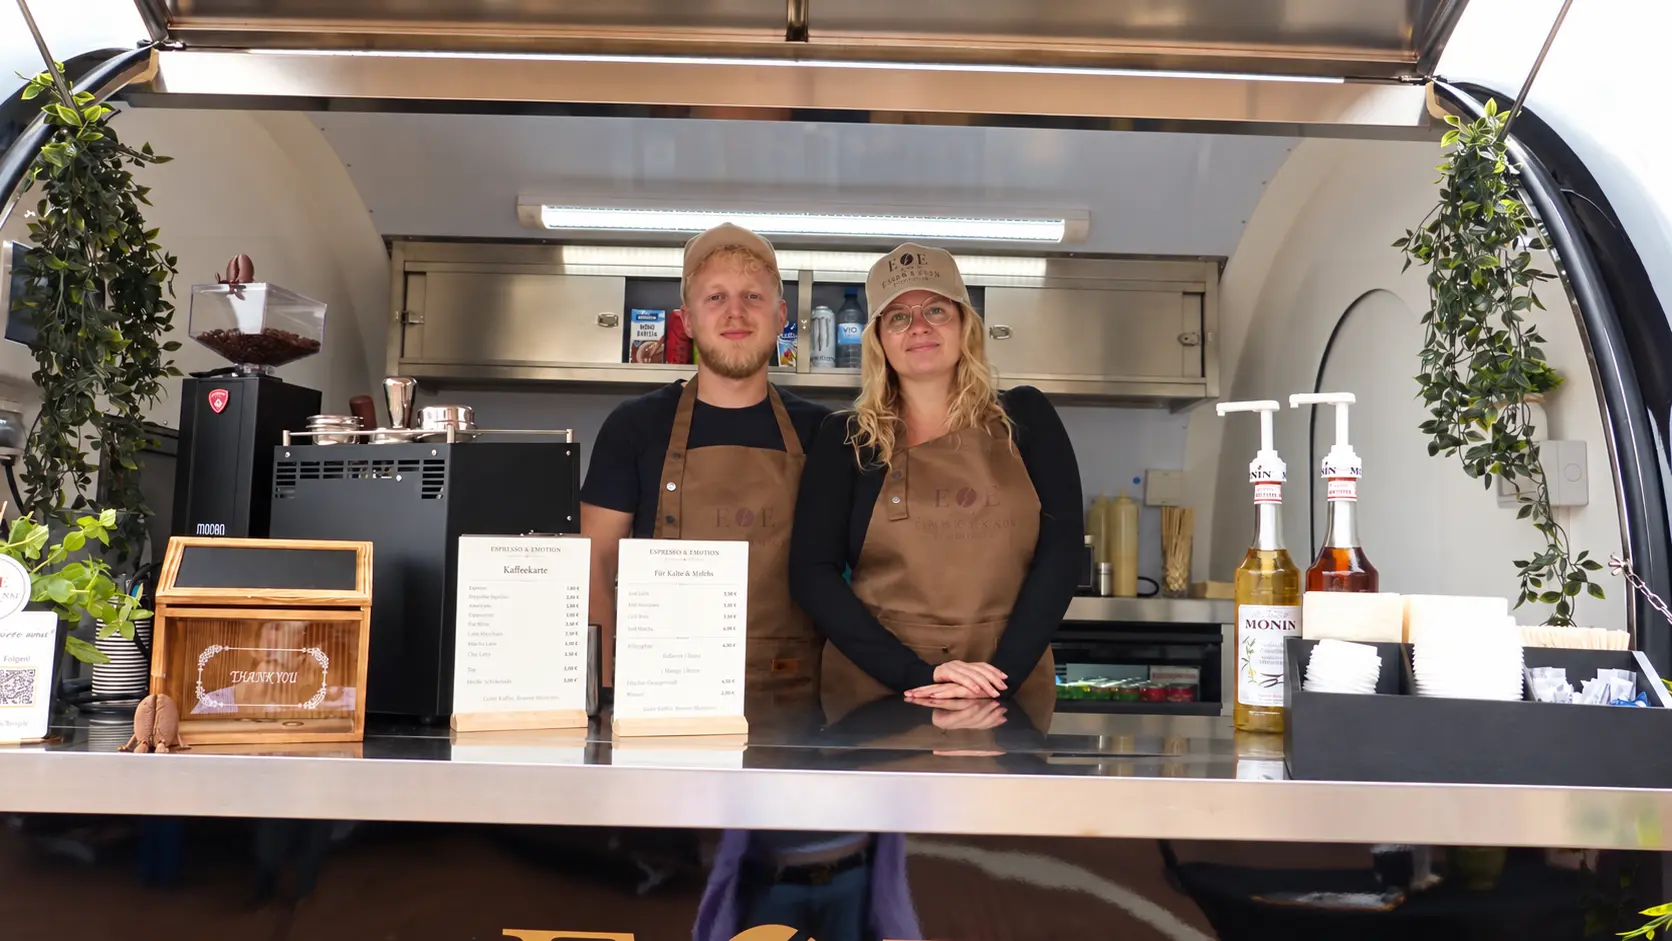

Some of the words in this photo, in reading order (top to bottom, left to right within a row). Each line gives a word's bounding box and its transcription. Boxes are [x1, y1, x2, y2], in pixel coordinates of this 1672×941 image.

[503, 565, 548, 574] Kaffeekarte
[1245, 619, 1296, 630] MONIN
[230, 670, 275, 684] THANK
[276, 672, 298, 683] YOU
